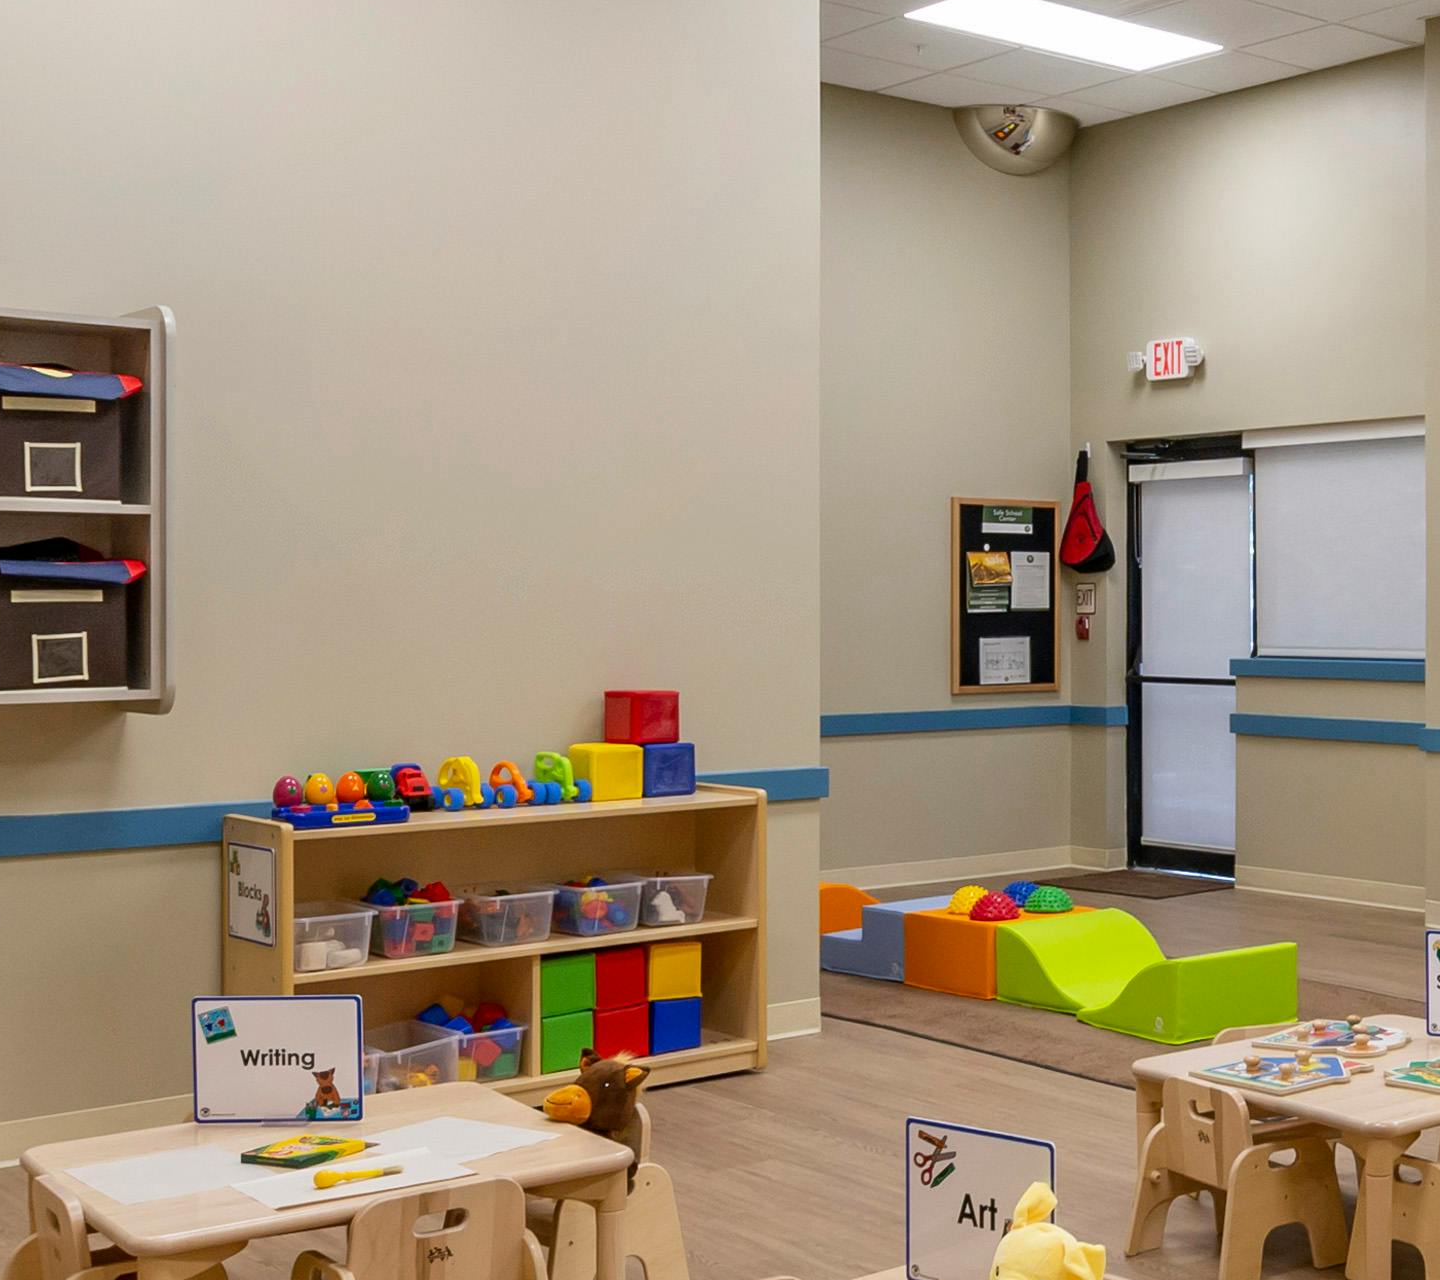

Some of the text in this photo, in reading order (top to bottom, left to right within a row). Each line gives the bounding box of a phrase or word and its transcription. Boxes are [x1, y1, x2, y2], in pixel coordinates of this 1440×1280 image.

[1153, 340, 1183, 376] EXIT
[1077, 589, 1093, 606] EXIT
[238, 881, 262, 901] Blocks
[240, 1049, 315, 1070] Writing
[957, 1193, 998, 1231] Art
